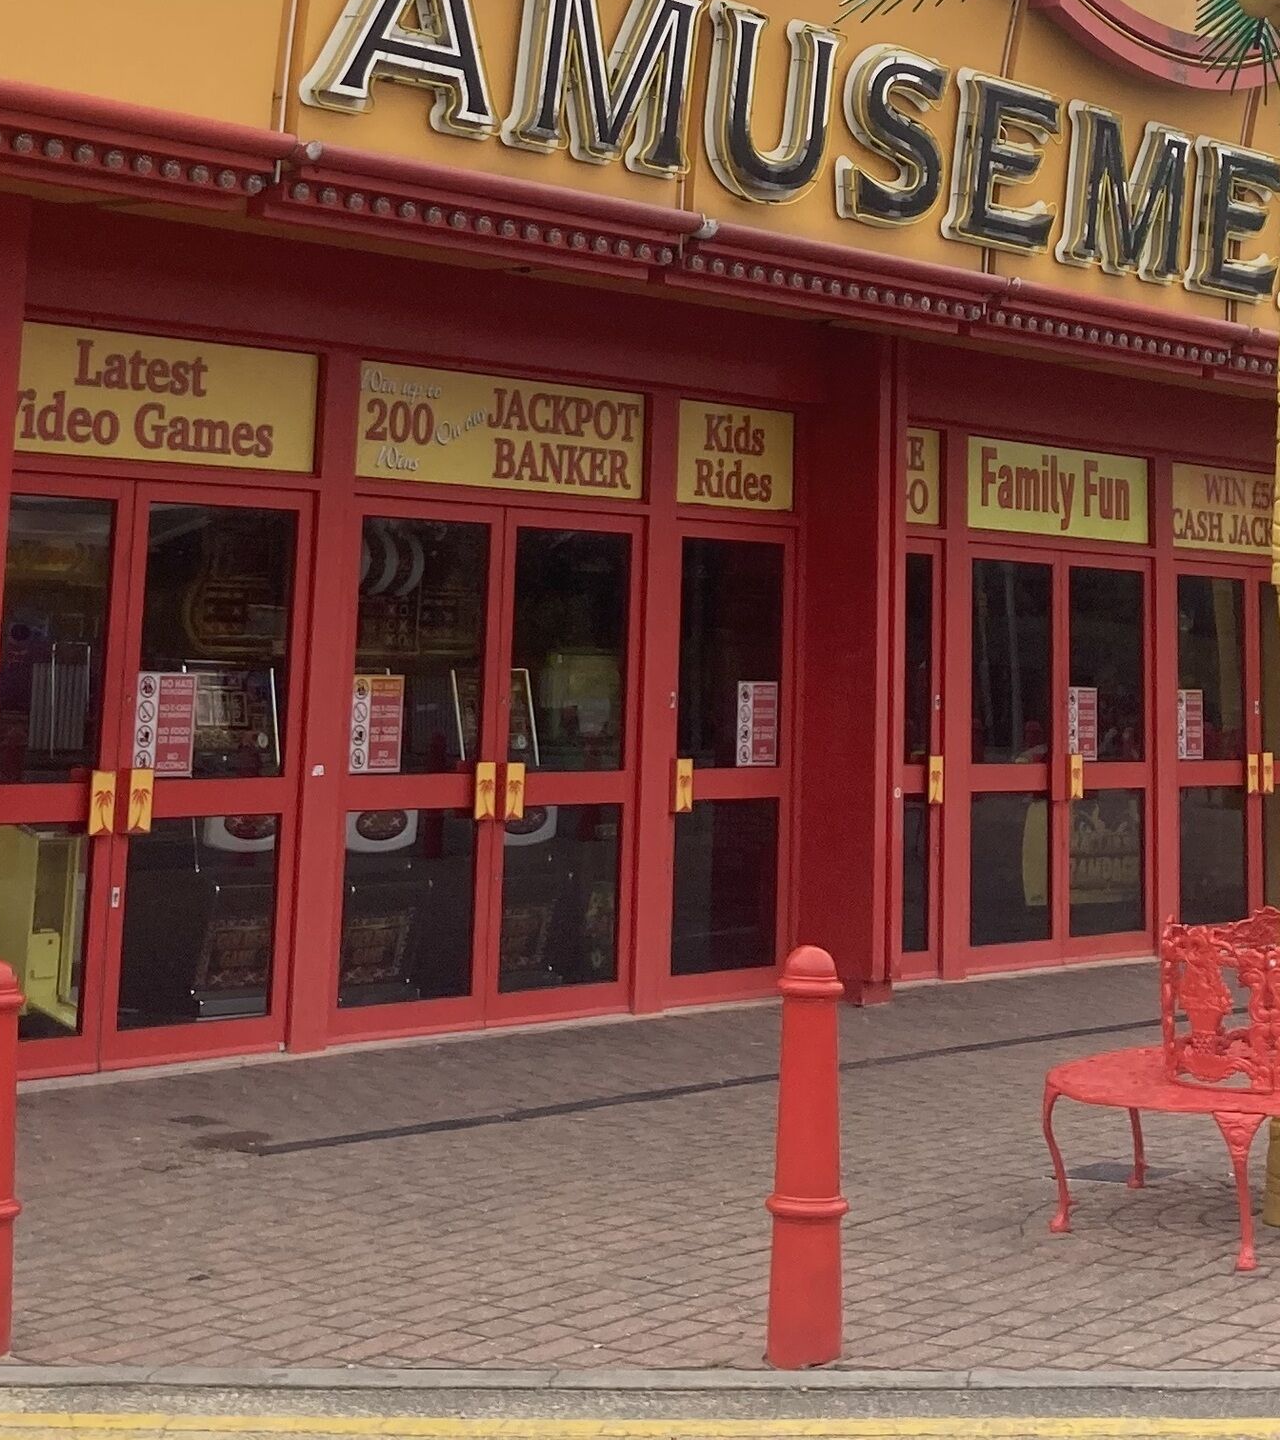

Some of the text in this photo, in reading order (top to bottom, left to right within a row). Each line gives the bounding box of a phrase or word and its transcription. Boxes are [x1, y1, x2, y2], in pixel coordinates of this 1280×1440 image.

[74, 338, 209, 398] Latest
[17, 388, 274, 458] ideo Games
[364, 397, 435, 446] 200
[487, 387, 641, 443] JACKPOT
[704, 412, 766, 457] Kids
[375, 445, 420, 472] Wins
[492, 437, 632, 491] BANKER
[694, 458, 773, 503] Rides
[980, 446, 1131, 531] Family Fun
[1204, 473, 1275, 511] WIN £5
[1173, 508, 1223, 543] CASH
